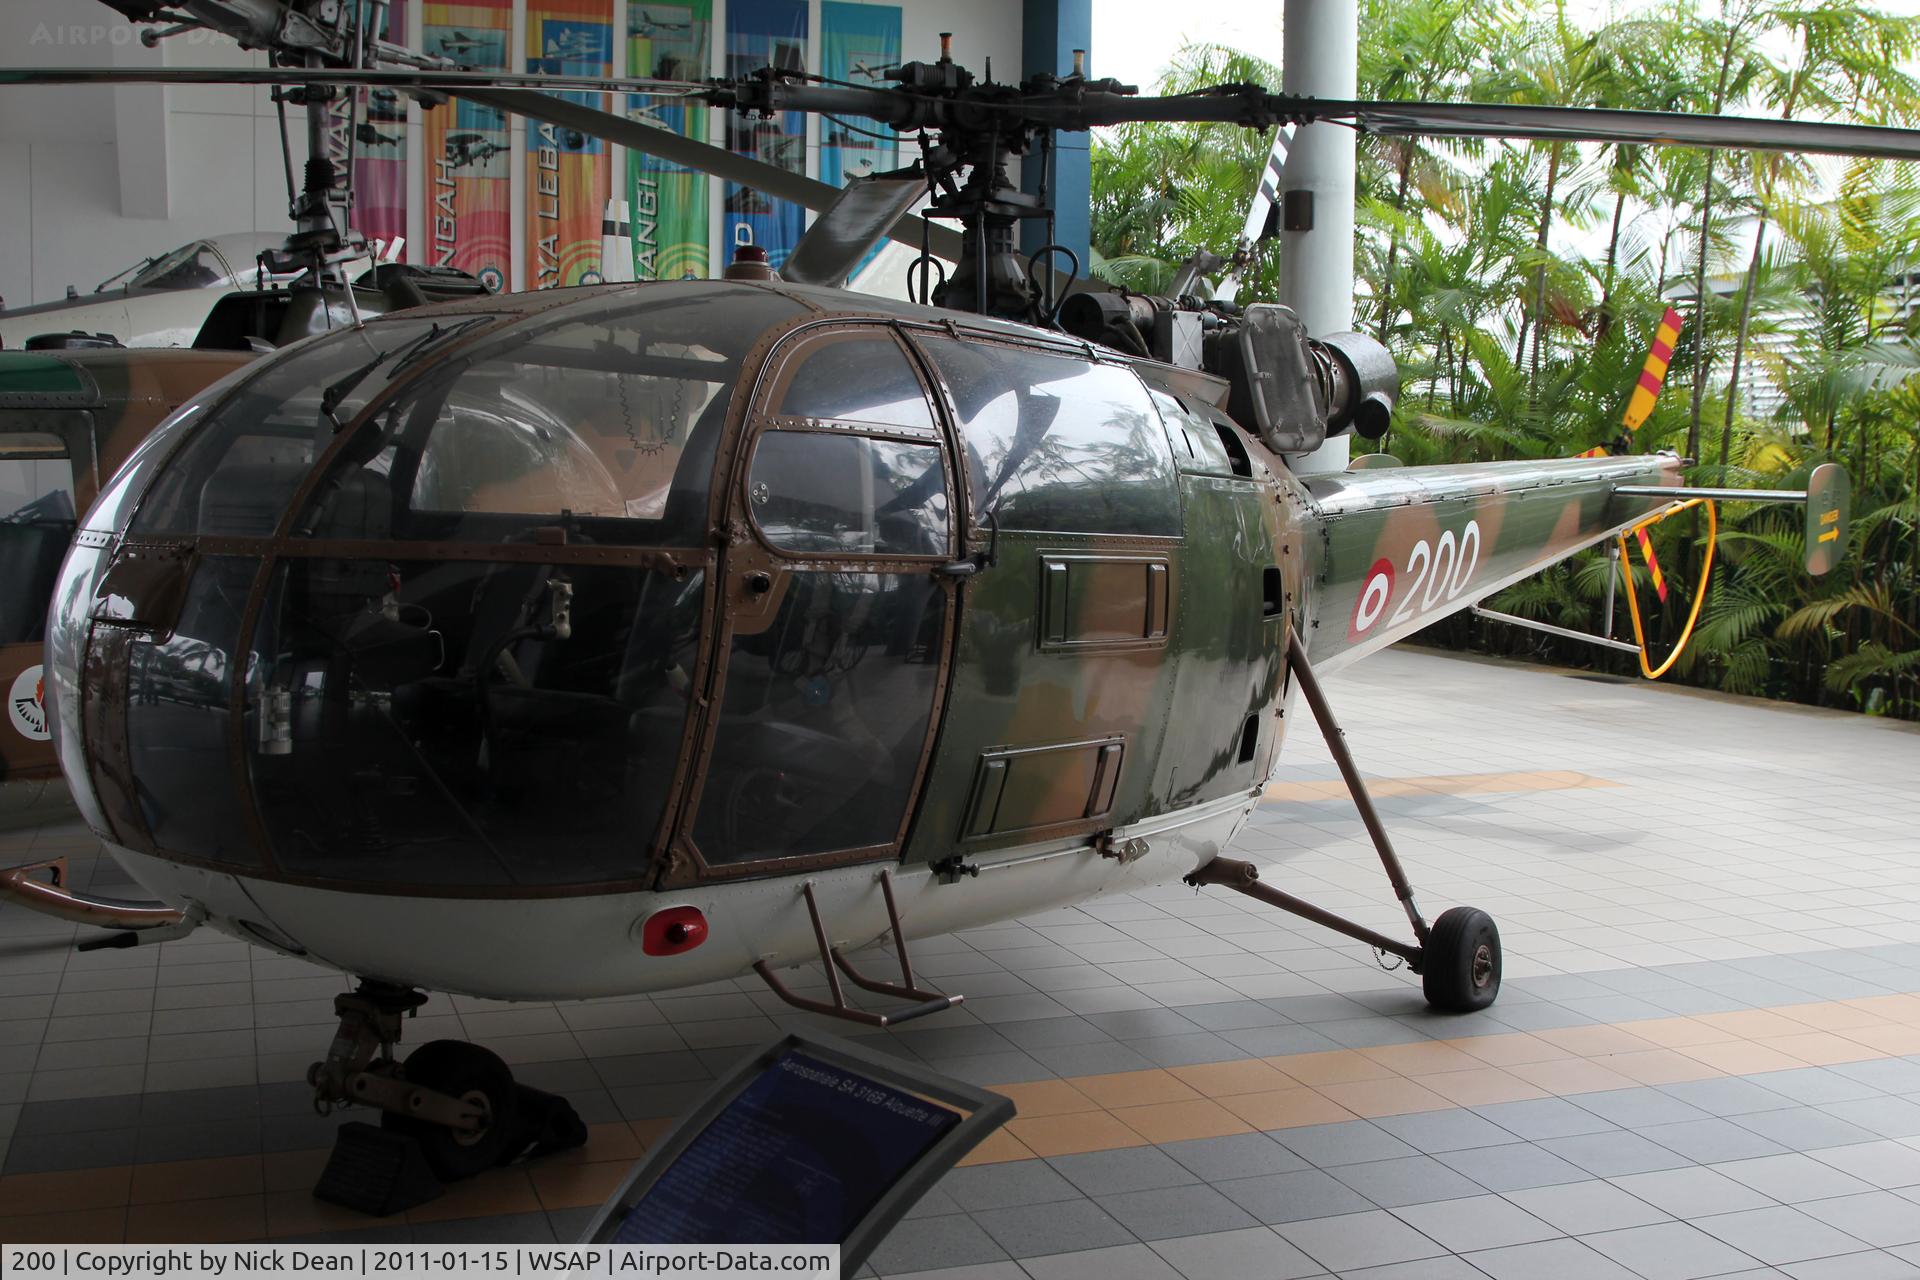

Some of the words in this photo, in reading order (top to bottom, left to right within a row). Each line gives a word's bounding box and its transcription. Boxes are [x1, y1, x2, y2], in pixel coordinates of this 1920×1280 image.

[537, 121, 560, 220] LEBA
[1385, 519, 1480, 629] 200
[837, 1078, 858, 1095] SA
[881, 1096, 930, 1123] Alouette
